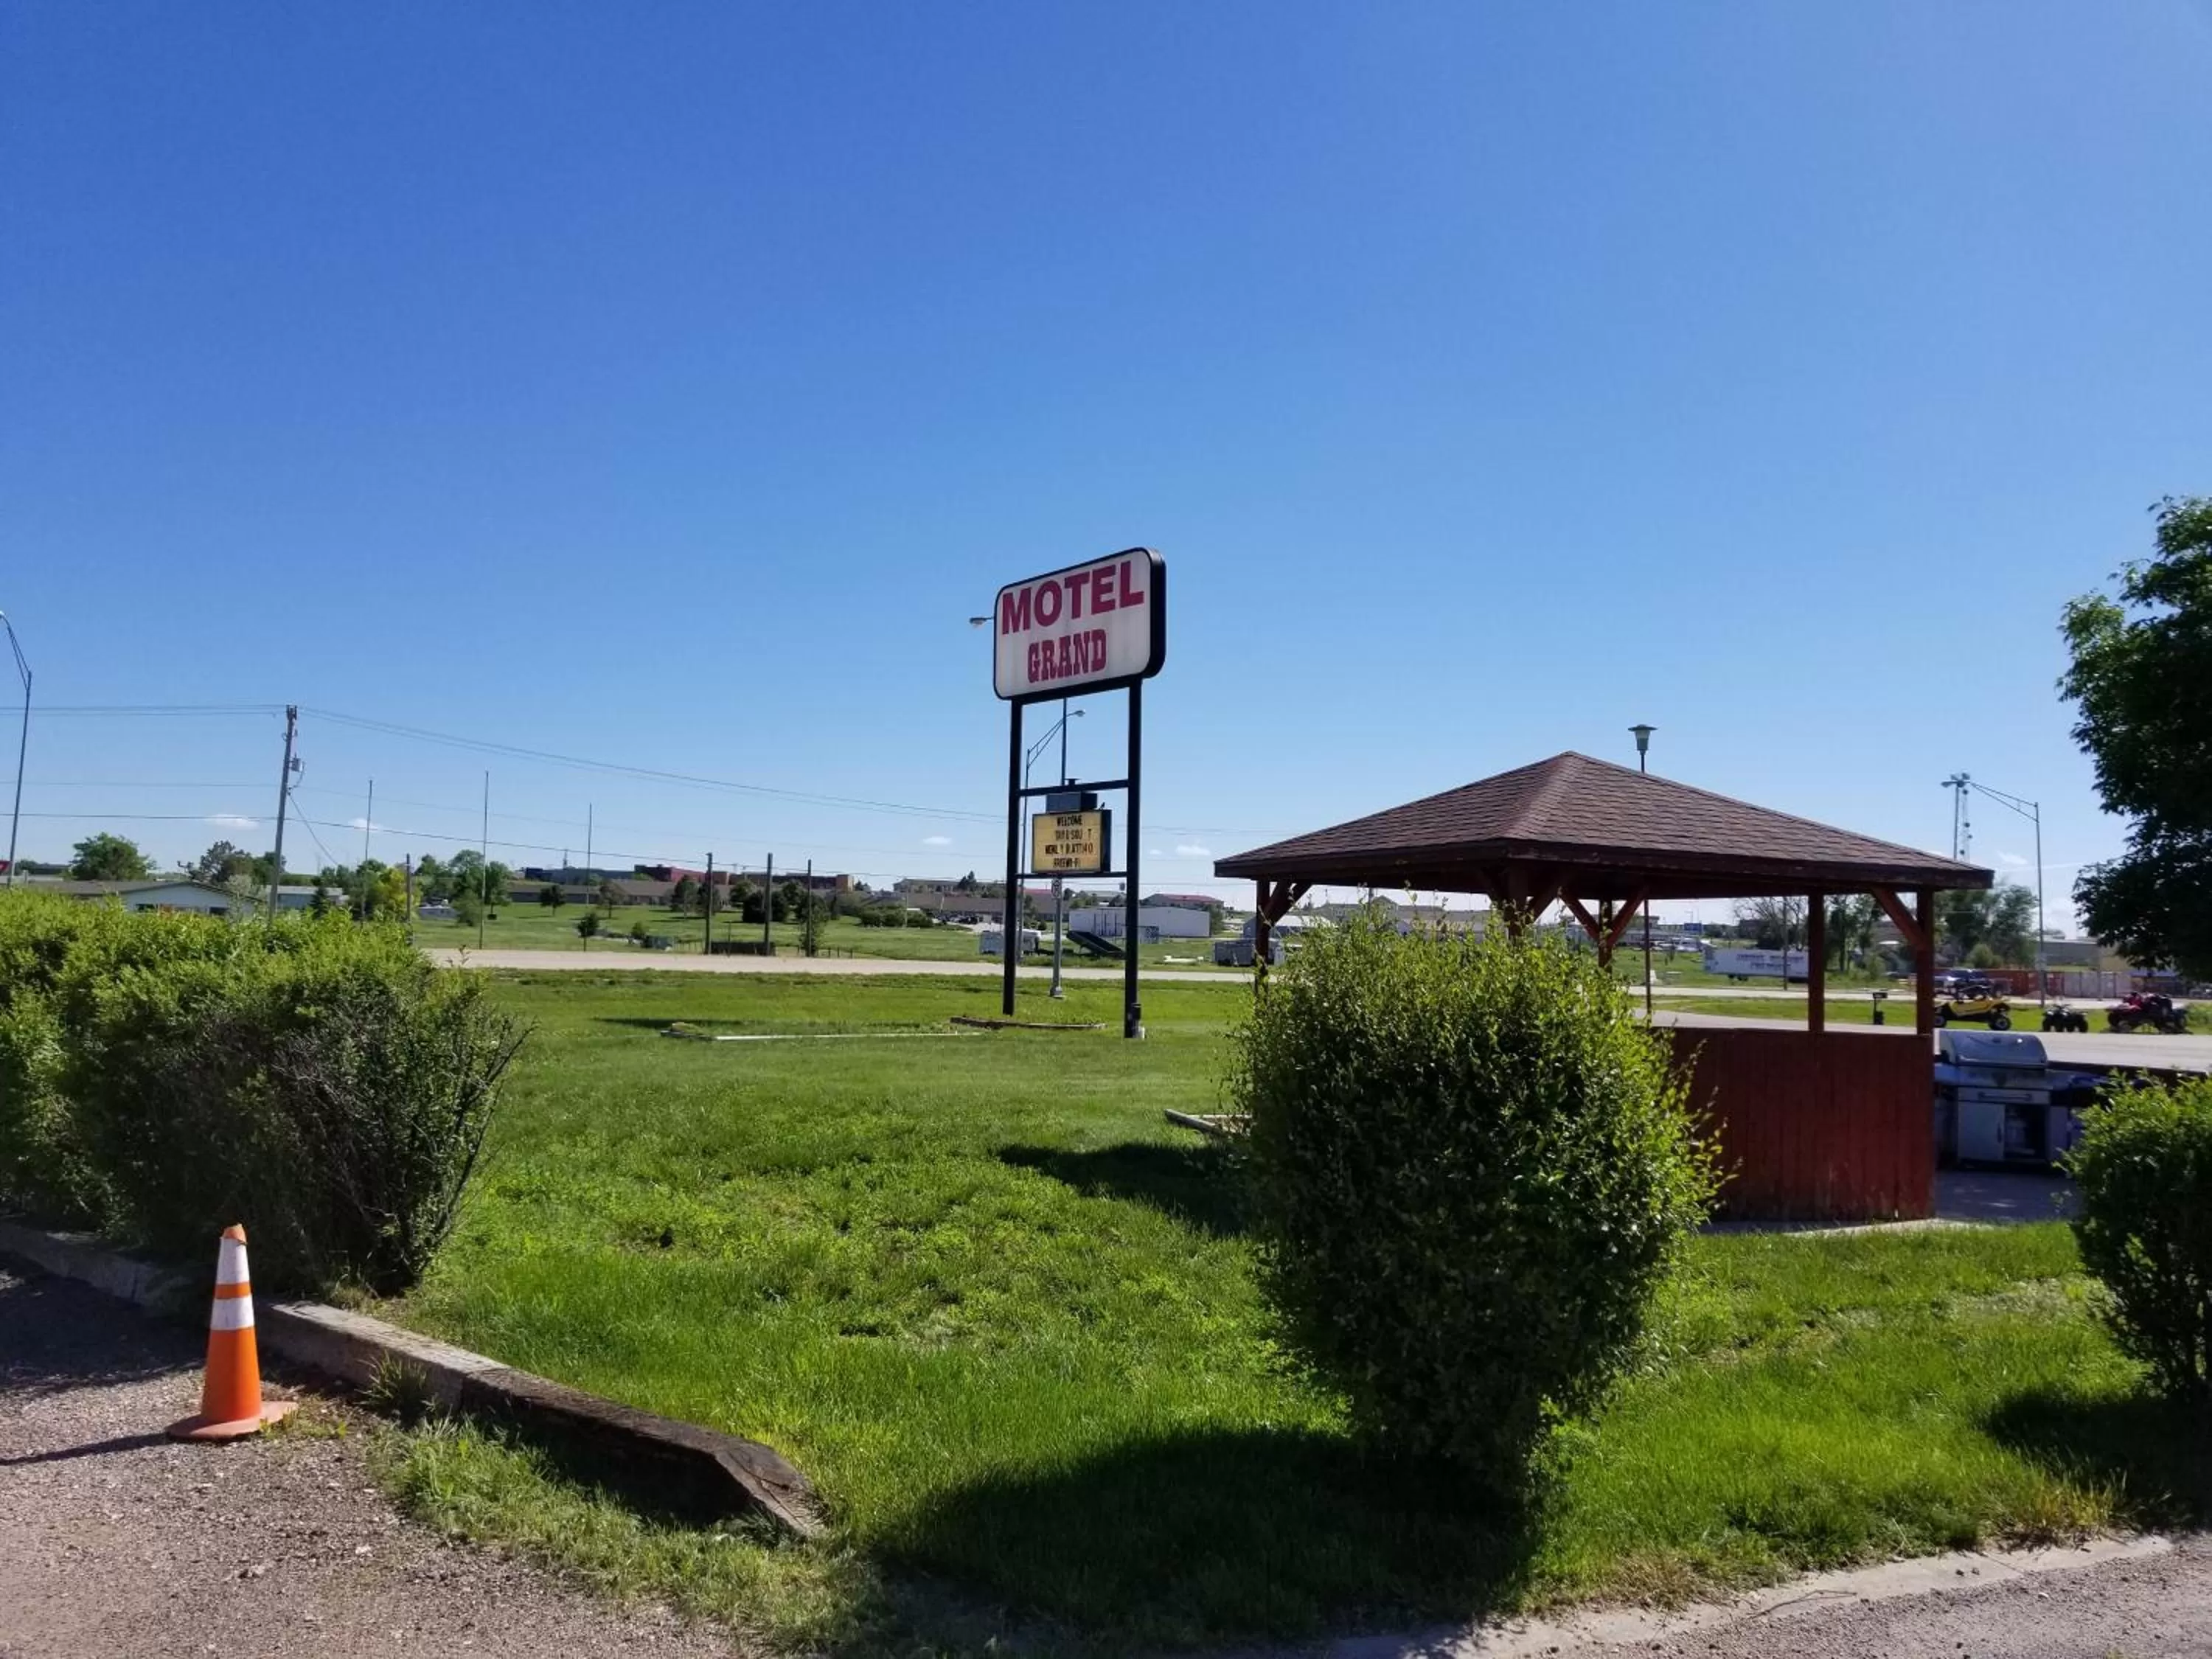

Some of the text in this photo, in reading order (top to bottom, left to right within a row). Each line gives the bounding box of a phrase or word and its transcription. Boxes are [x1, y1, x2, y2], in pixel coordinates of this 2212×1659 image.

[1001, 560, 1144, 636] MOTEL
[1027, 628, 1107, 684] GRAND
[1057, 815, 1082, 827] WELCOME
